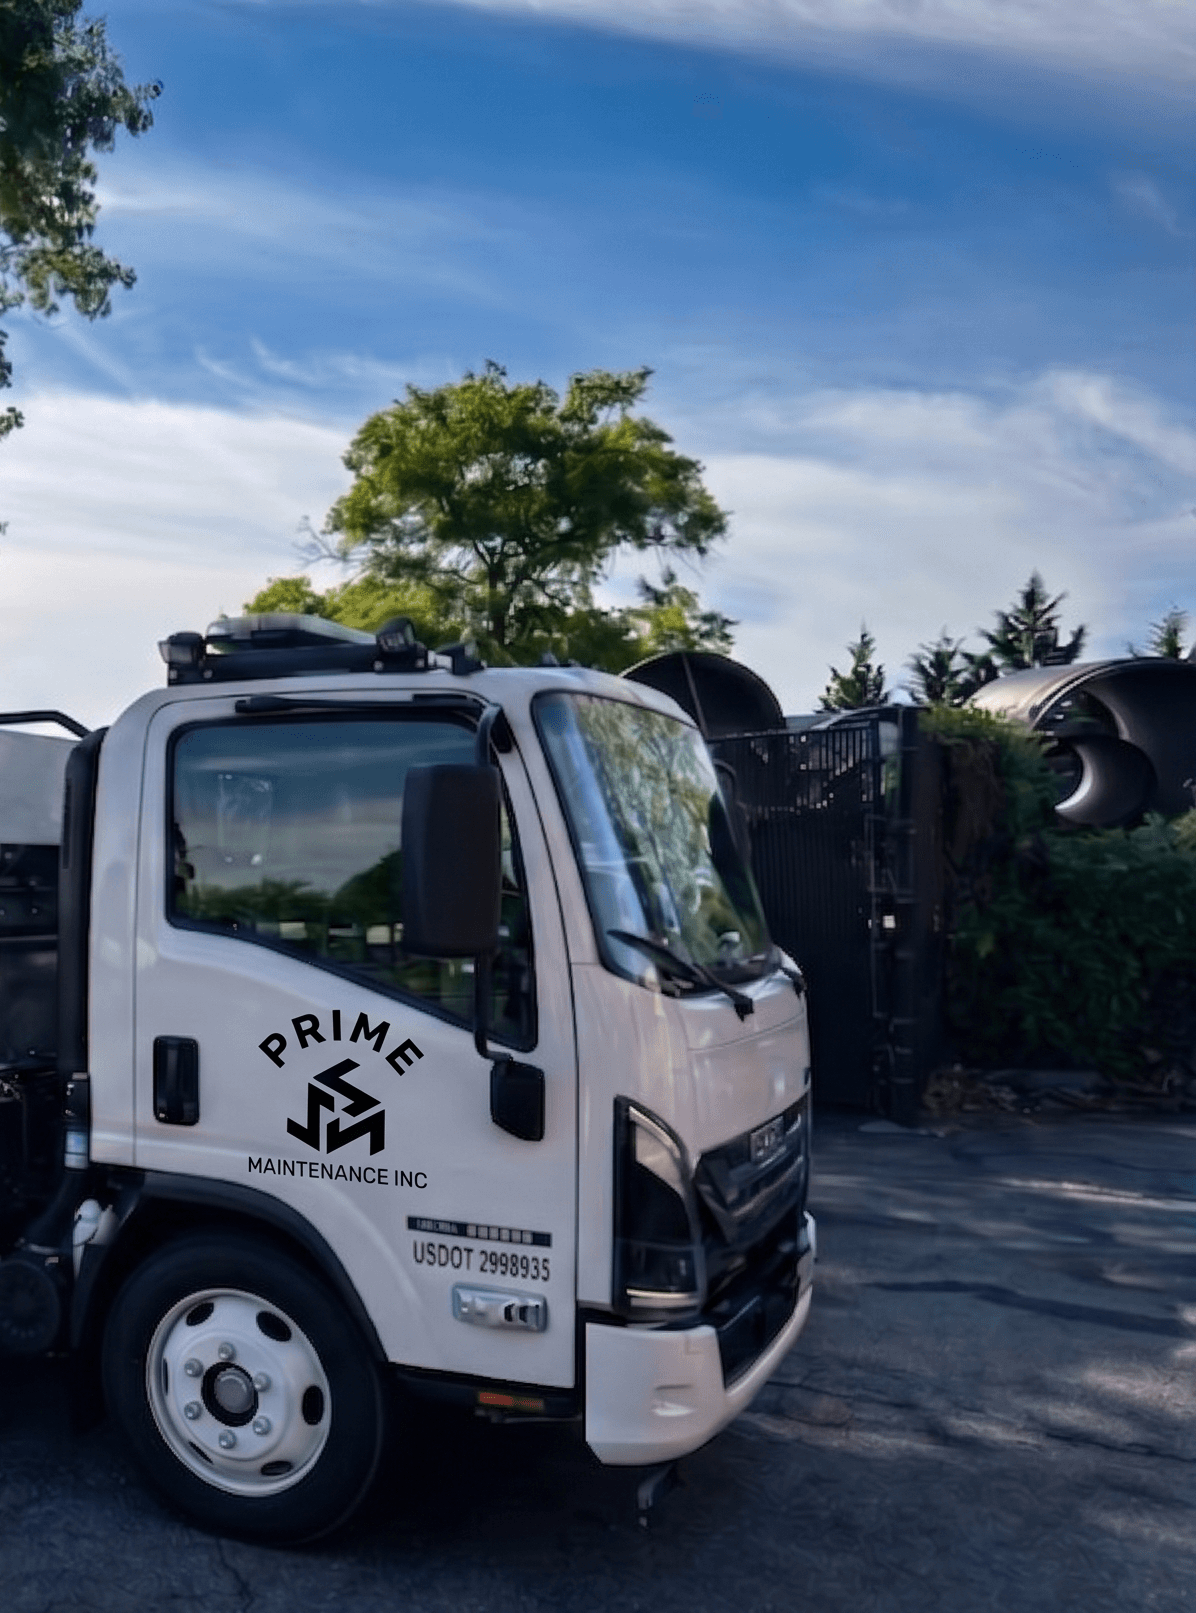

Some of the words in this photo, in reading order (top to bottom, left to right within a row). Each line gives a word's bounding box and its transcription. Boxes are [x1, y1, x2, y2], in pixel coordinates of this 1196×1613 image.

[258, 1009, 425, 1077] PRIME
[248, 1156, 389, 1186] MAINTENANCE
[394, 1169, 428, 1189] INC
[413, 1239, 474, 1271] USDOT
[479, 1249, 551, 1282] 2998935
